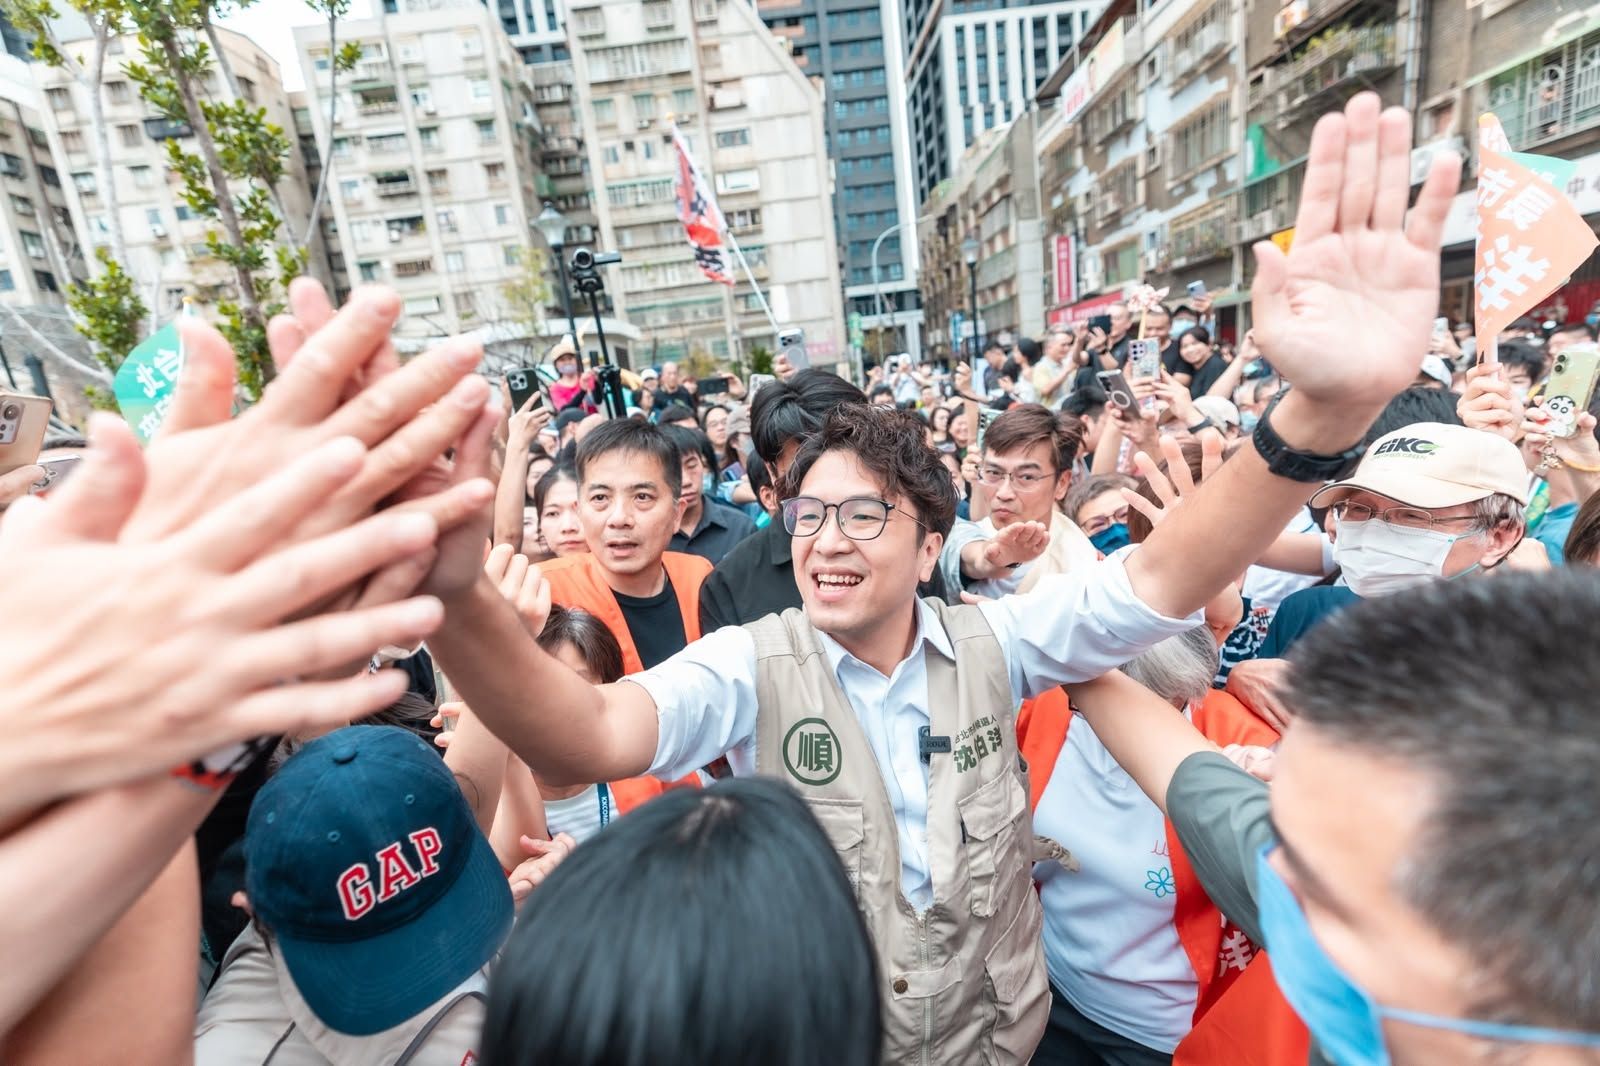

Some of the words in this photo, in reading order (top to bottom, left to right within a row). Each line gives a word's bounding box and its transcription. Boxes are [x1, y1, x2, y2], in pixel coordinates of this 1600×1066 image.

[1475, 213, 1551, 311] 洋
[795, 731, 833, 773] 順
[336, 826, 443, 921] GAP
[1218, 912, 1252, 977] 洋
